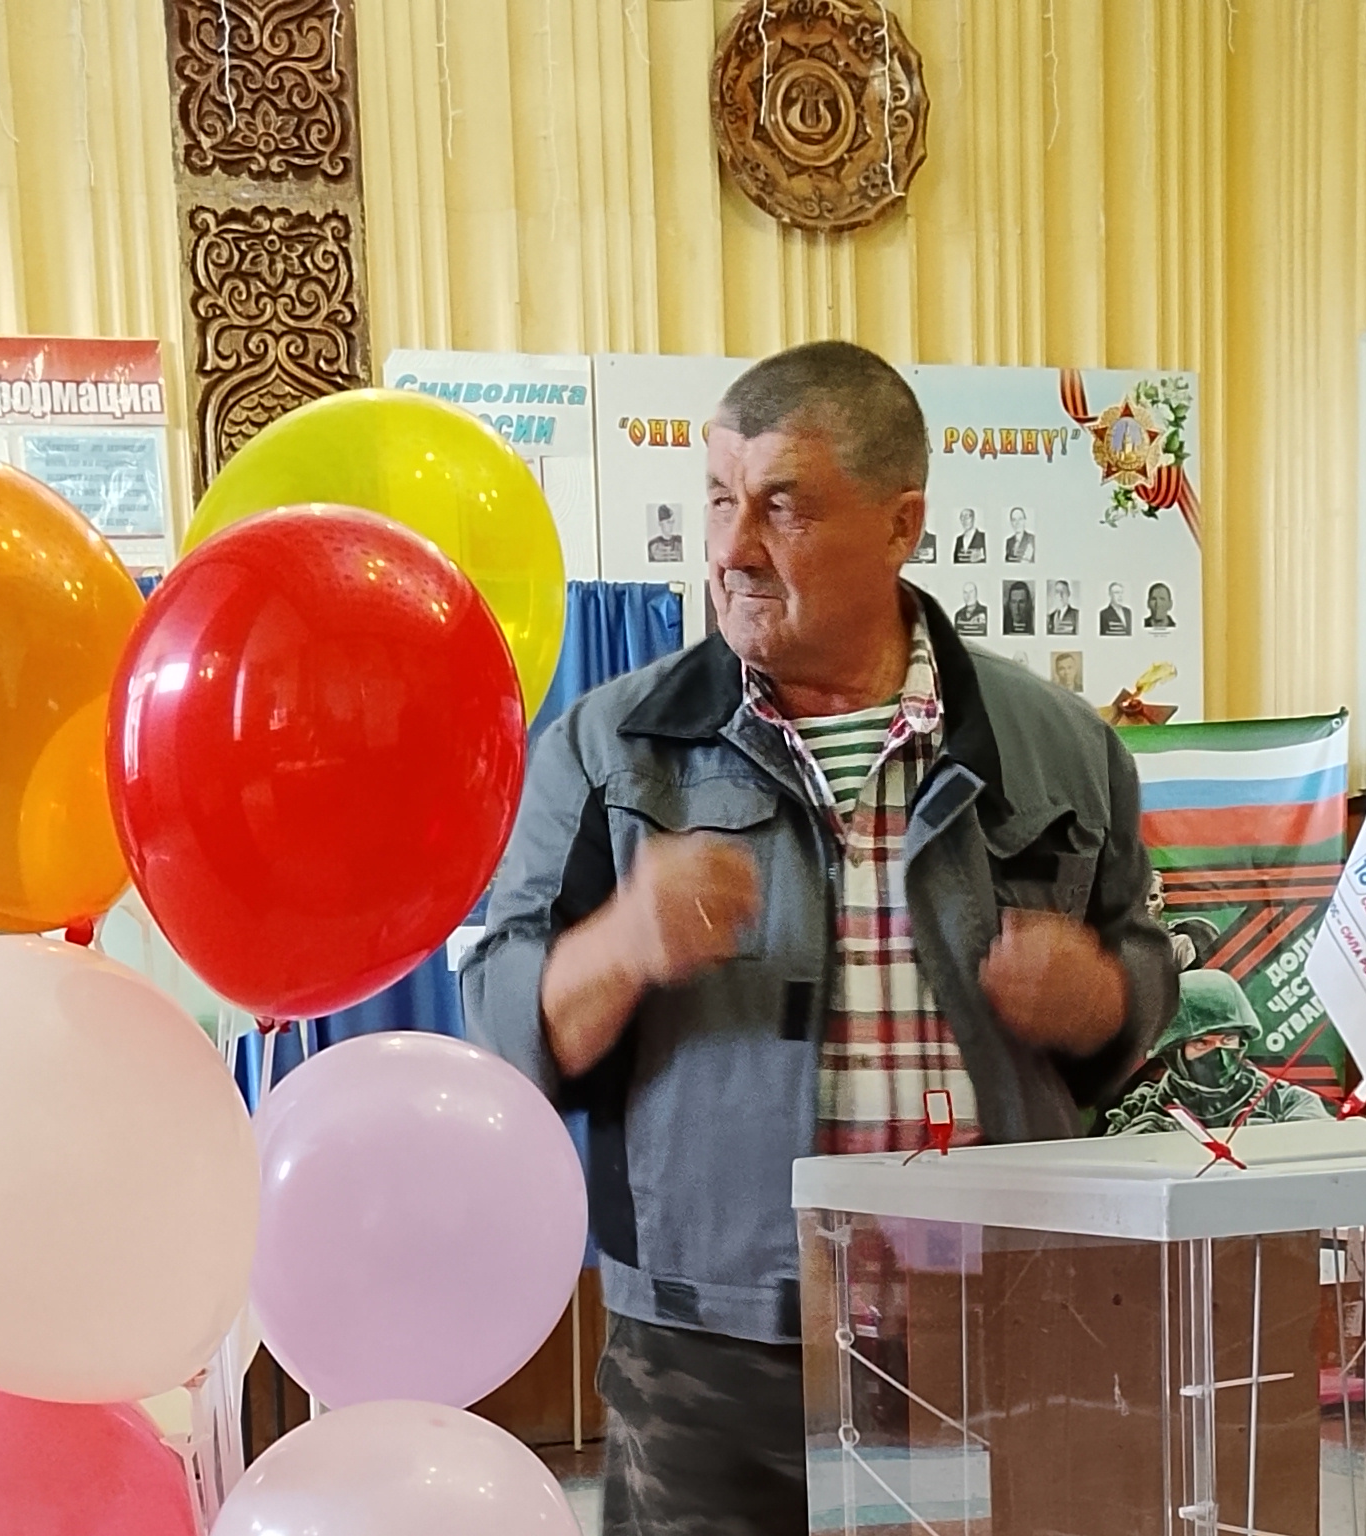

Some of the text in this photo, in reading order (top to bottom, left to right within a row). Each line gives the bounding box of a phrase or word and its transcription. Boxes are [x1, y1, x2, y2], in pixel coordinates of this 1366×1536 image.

[394, 374, 587, 406] Символика
[1340, 925, 1363, 957] СИЛА
[1266, 971, 1311, 1012] ЧЕС
[1265, 996, 1325, 1053] ОТВА
